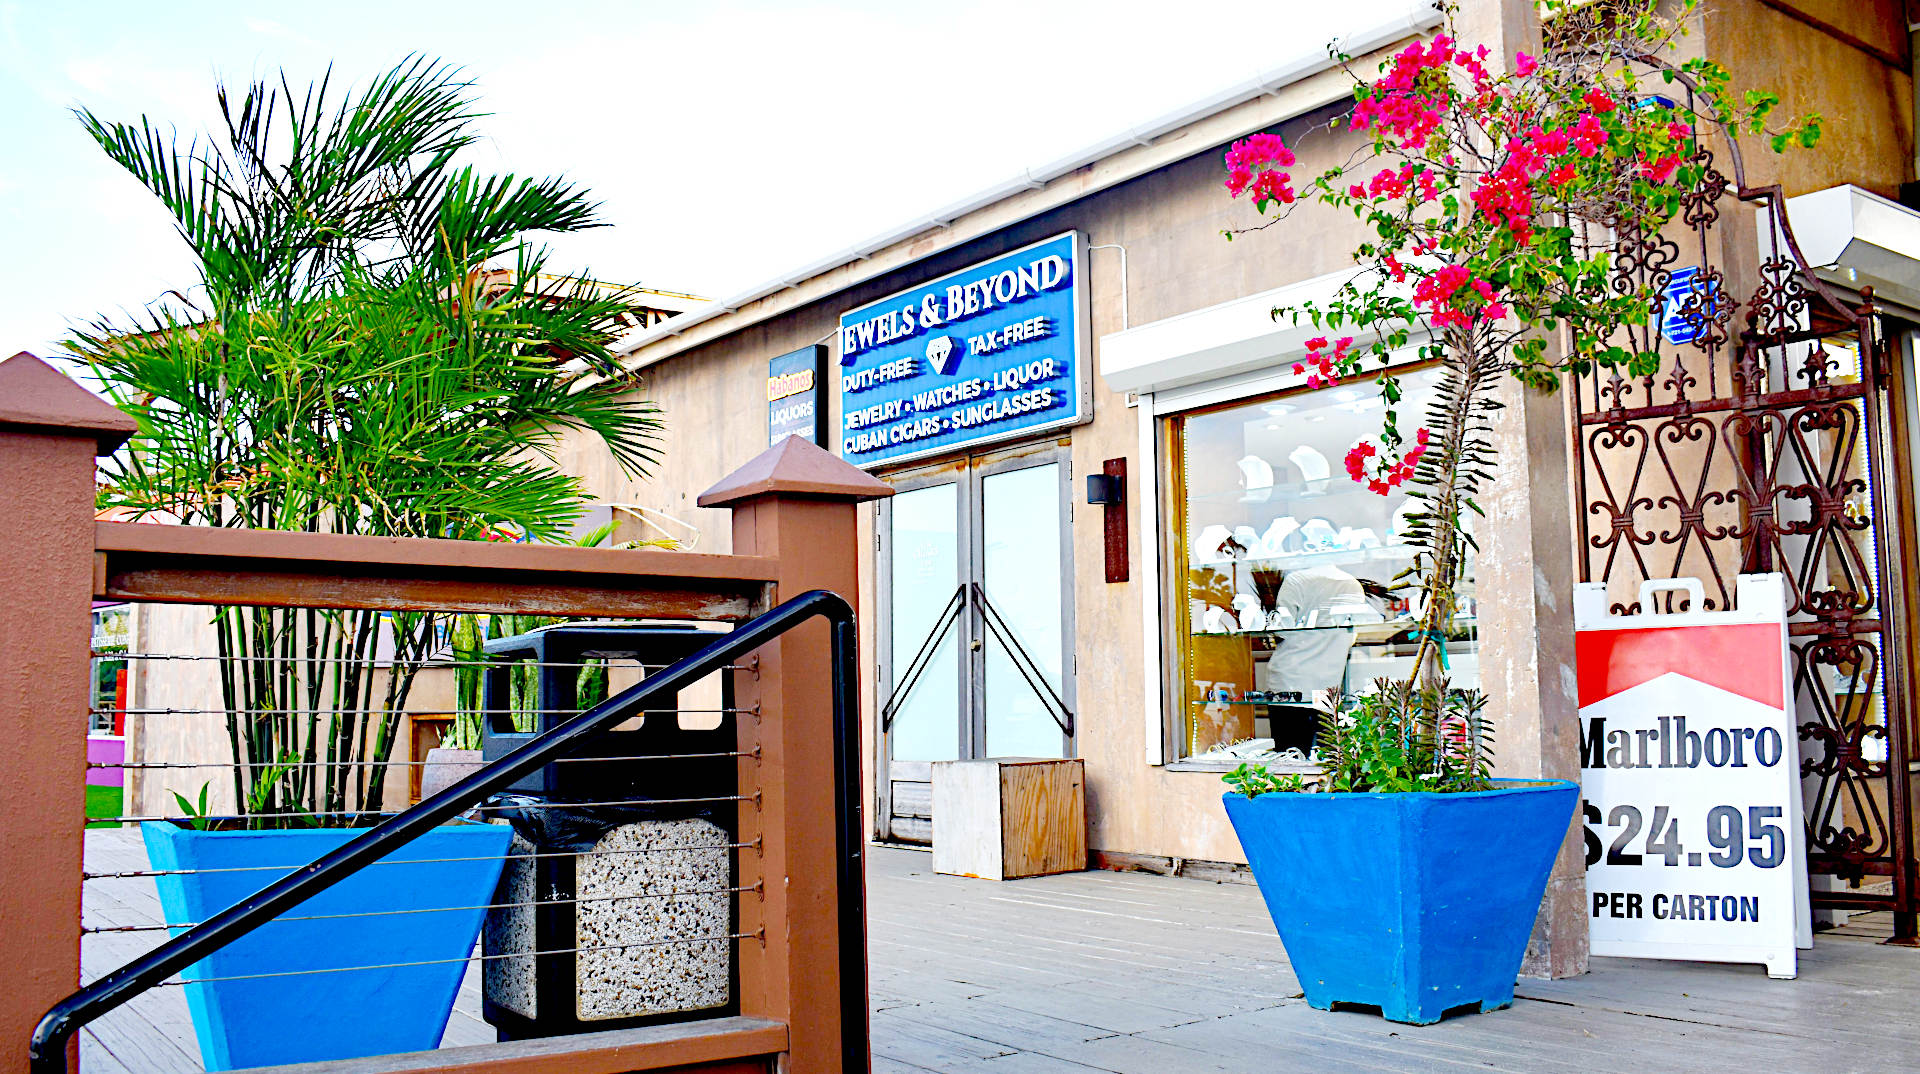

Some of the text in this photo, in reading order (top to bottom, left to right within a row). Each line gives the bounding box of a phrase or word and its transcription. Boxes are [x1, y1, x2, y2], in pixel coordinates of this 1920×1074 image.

[835, 254, 1064, 366] JEWELS & BEYOND
[1664, 288, 1707, 322] AD
[843, 315, 1045, 392] DUTY-FREE TAX-FREE
[769, 372, 812, 398] Habanos
[771, 400, 814, 425] LIQUORS
[845, 358, 1054, 430] JEWELRY WATCHES LIQUOR
[844, 388, 1052, 454] CUBAN CIGARS SUNGLASSES
[1579, 715, 1783, 769] Marlboro
[1584, 799, 1786, 871] $24.95
[1592, 892, 1759, 923] PER CARTON
